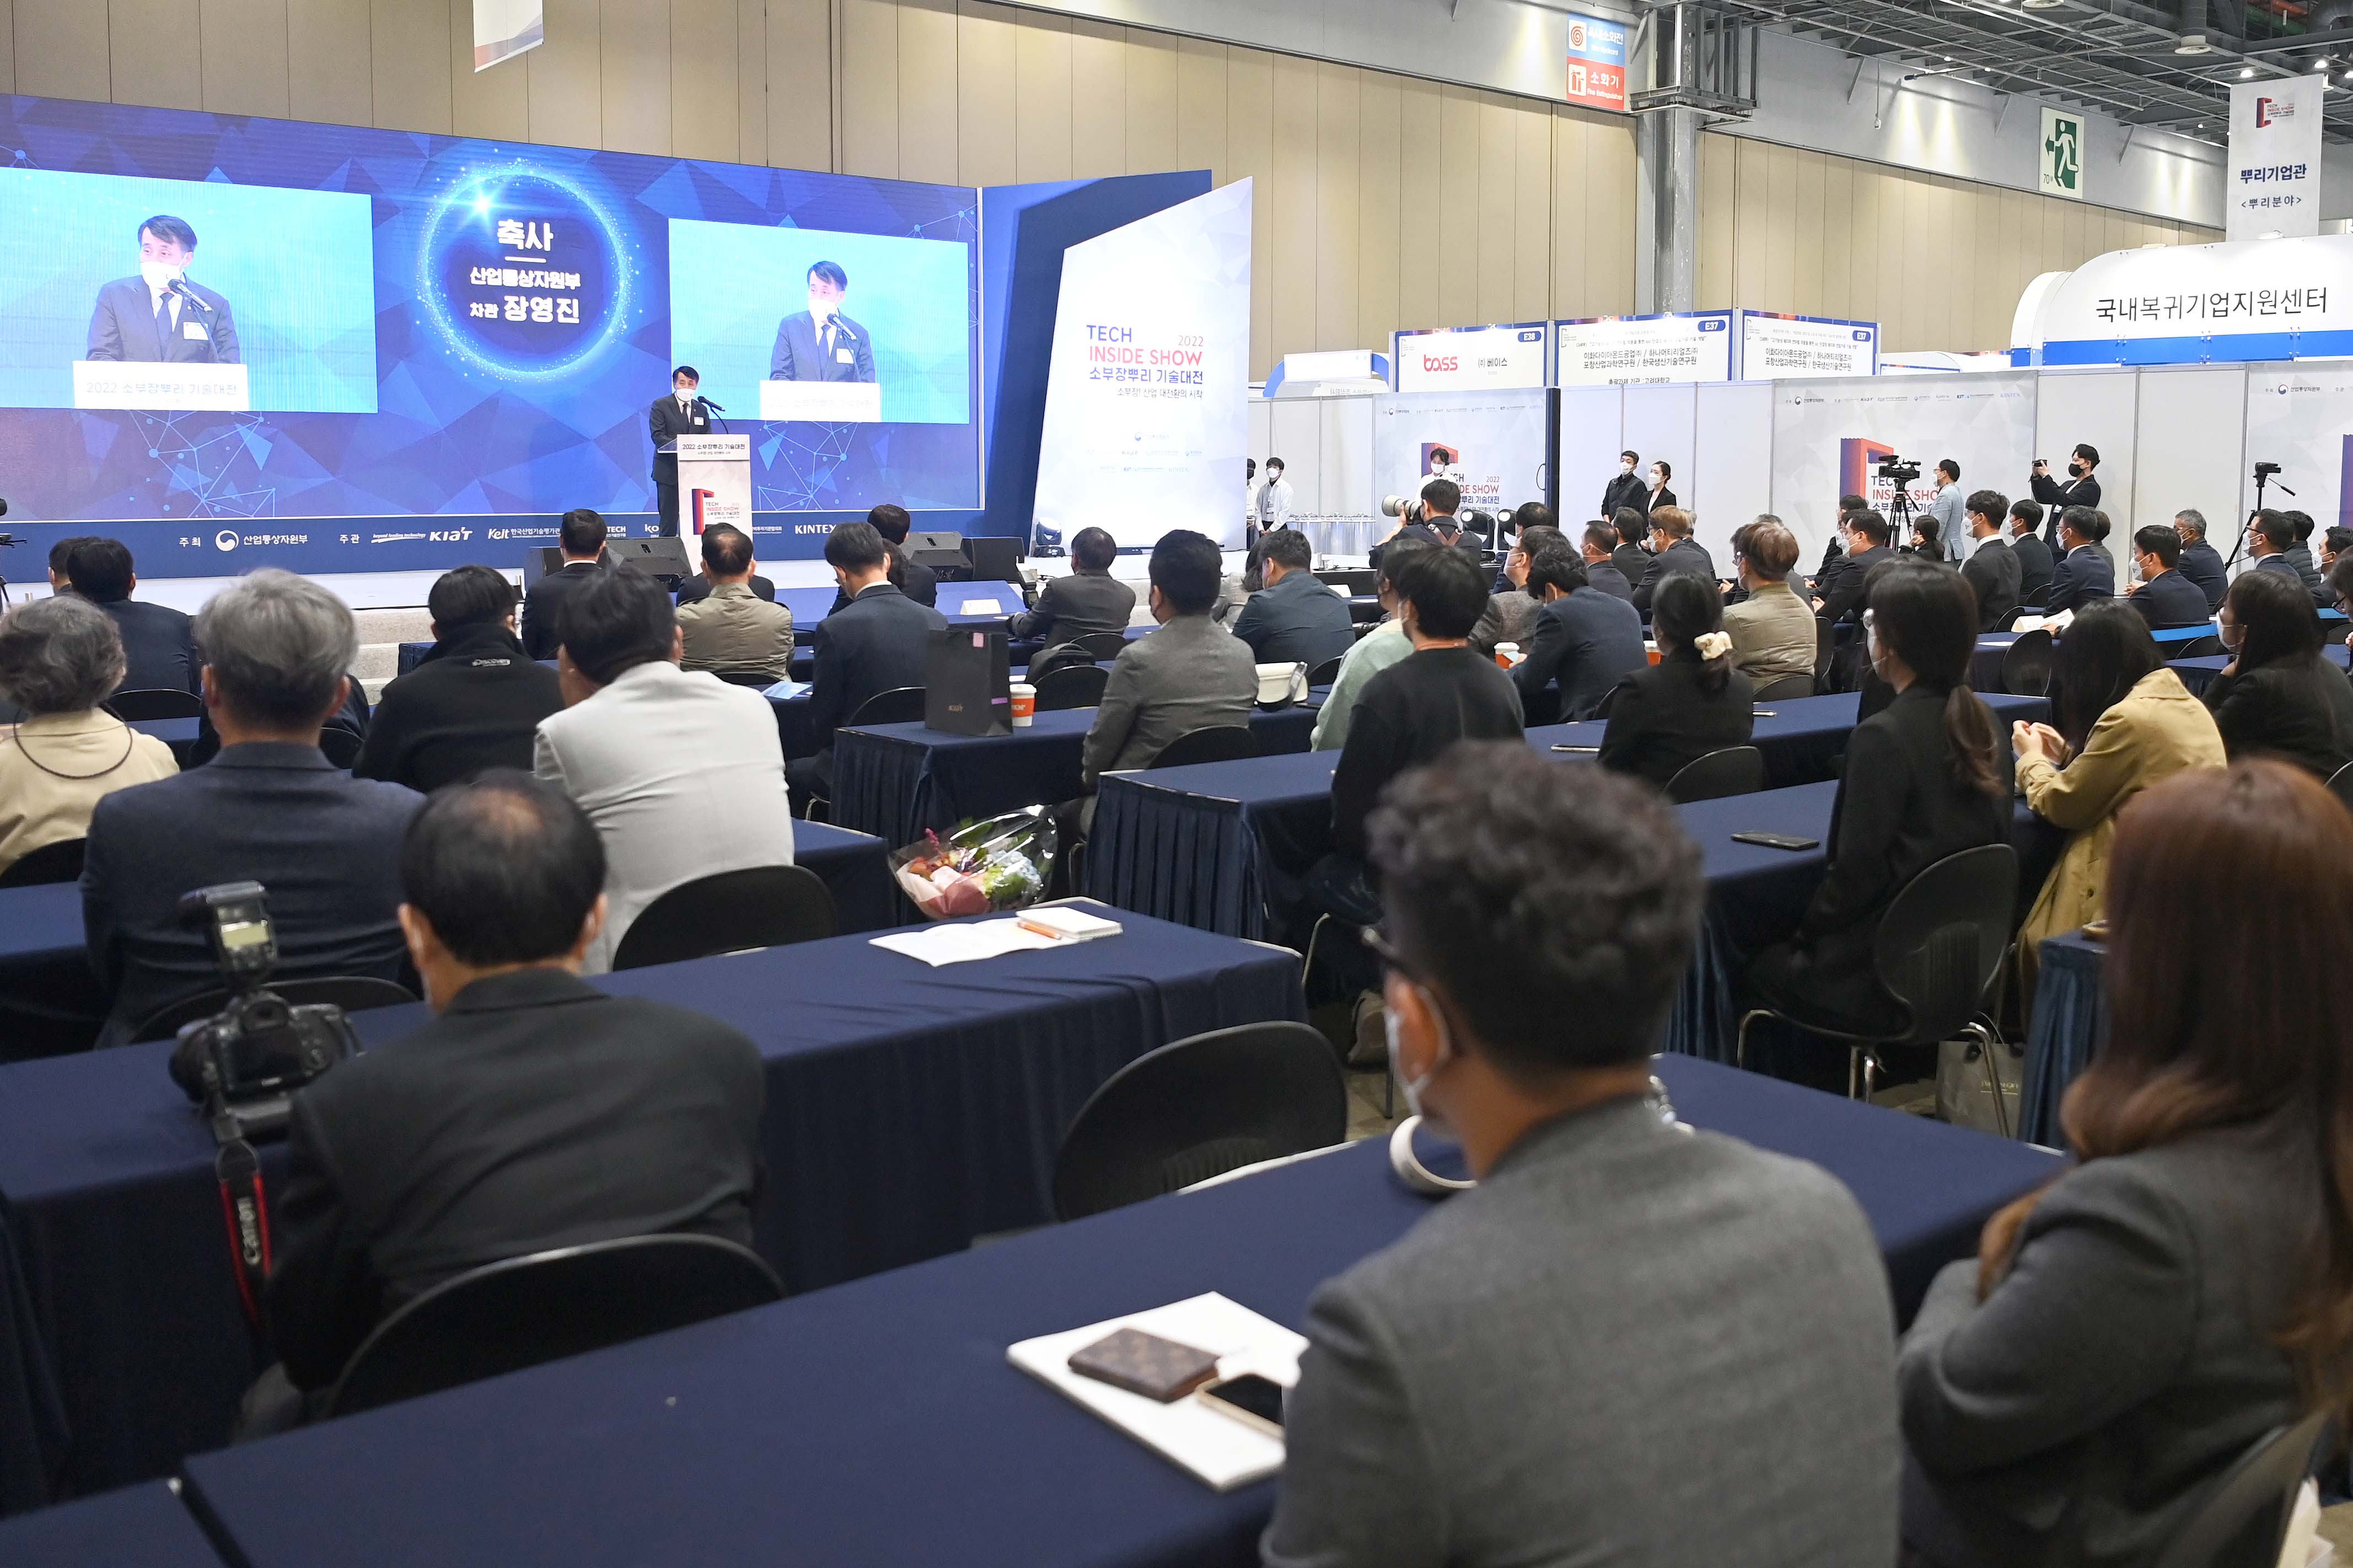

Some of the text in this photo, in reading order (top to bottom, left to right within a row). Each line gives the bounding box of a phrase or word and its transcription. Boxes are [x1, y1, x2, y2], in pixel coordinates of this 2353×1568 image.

[1590, 71, 1619, 89] 소화기
[2240, 164, 2307, 184] 뿌리기업관
[497, 219, 554, 251] 축사
[470, 267, 582, 290] 산업통상자원부
[469, 295, 580, 324] 차관 장영진
[2096, 287, 2327, 323] 국내복귀기업지원센터
[1705, 321, 1719, 331] E37
[1086, 325, 1132, 343] TECH
[1178, 335, 1204, 347] 2022
[1523, 332, 1536, 341] E38
[1089, 346, 1203, 367] INSIDE SHOW
[1487, 357, 1508, 367] 베이스
[1583, 359, 1635, 369] 포항산업과학연구원
[1642, 355, 1697, 367] 한국생산기술연구원
[1089, 367, 1204, 385] 소부장뿌리 기술대전
[86, 382, 237, 396] 2022 소부장뿌리 기술대전
[1143, 388, 1157, 398] 산업
[1189, 390, 1203, 400] 시작
[1871, 475, 1893, 487] TEC
[1472, 484, 1500, 494] SHOW
[1872, 489, 1938, 501] INSIE SHO
[1475, 495, 1500, 504] 기술대전
[243, 534, 308, 546] 산업통상자원부
